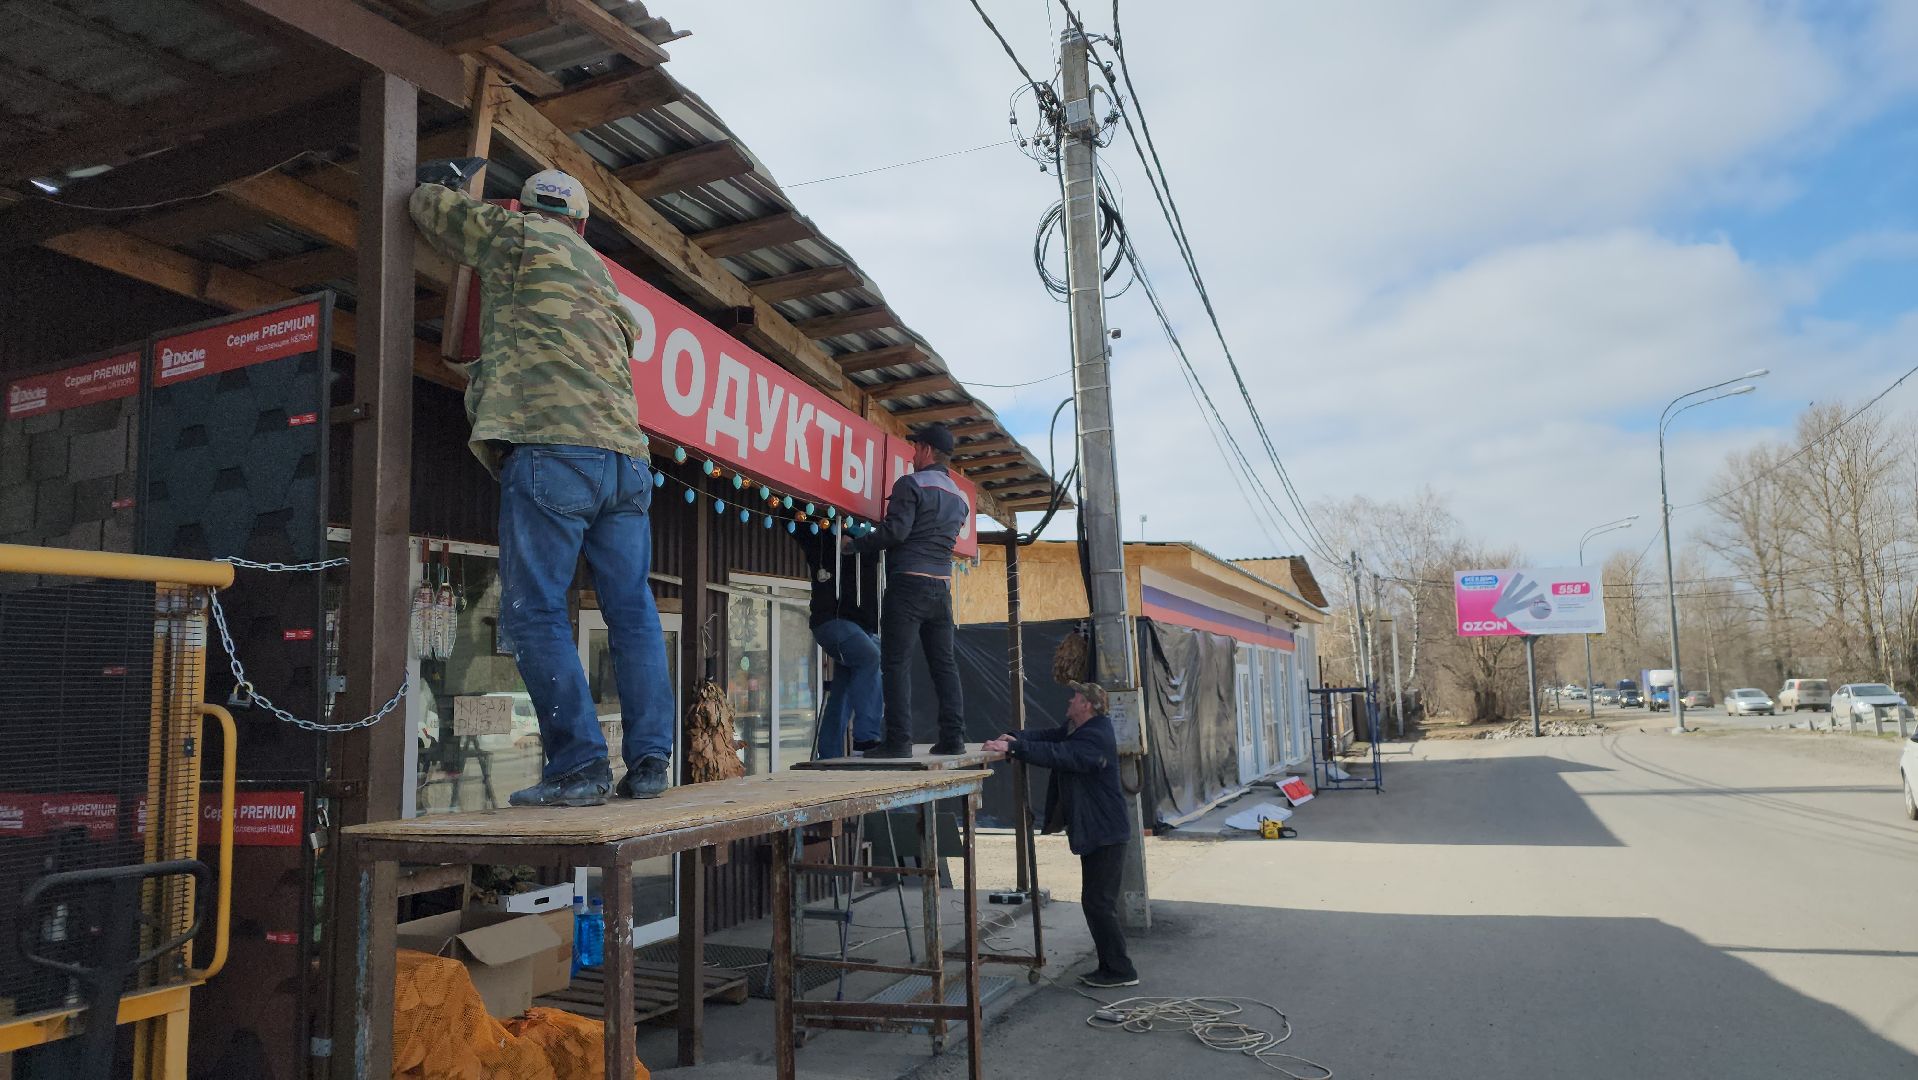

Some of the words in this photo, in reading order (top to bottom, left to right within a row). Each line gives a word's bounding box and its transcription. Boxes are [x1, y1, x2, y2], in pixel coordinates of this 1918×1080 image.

[536, 183, 572, 197] 2014
[226, 331, 260, 348] Серия
[262, 314, 315, 338] PREMIUM
[93, 360, 137, 380] PREMIUM
[619, 293, 874, 500] ОДУКТЫ
[1462, 621, 1508, 632] OZON
[204, 805, 237, 822] Сер
[240, 805, 296, 819] PREMIUM
